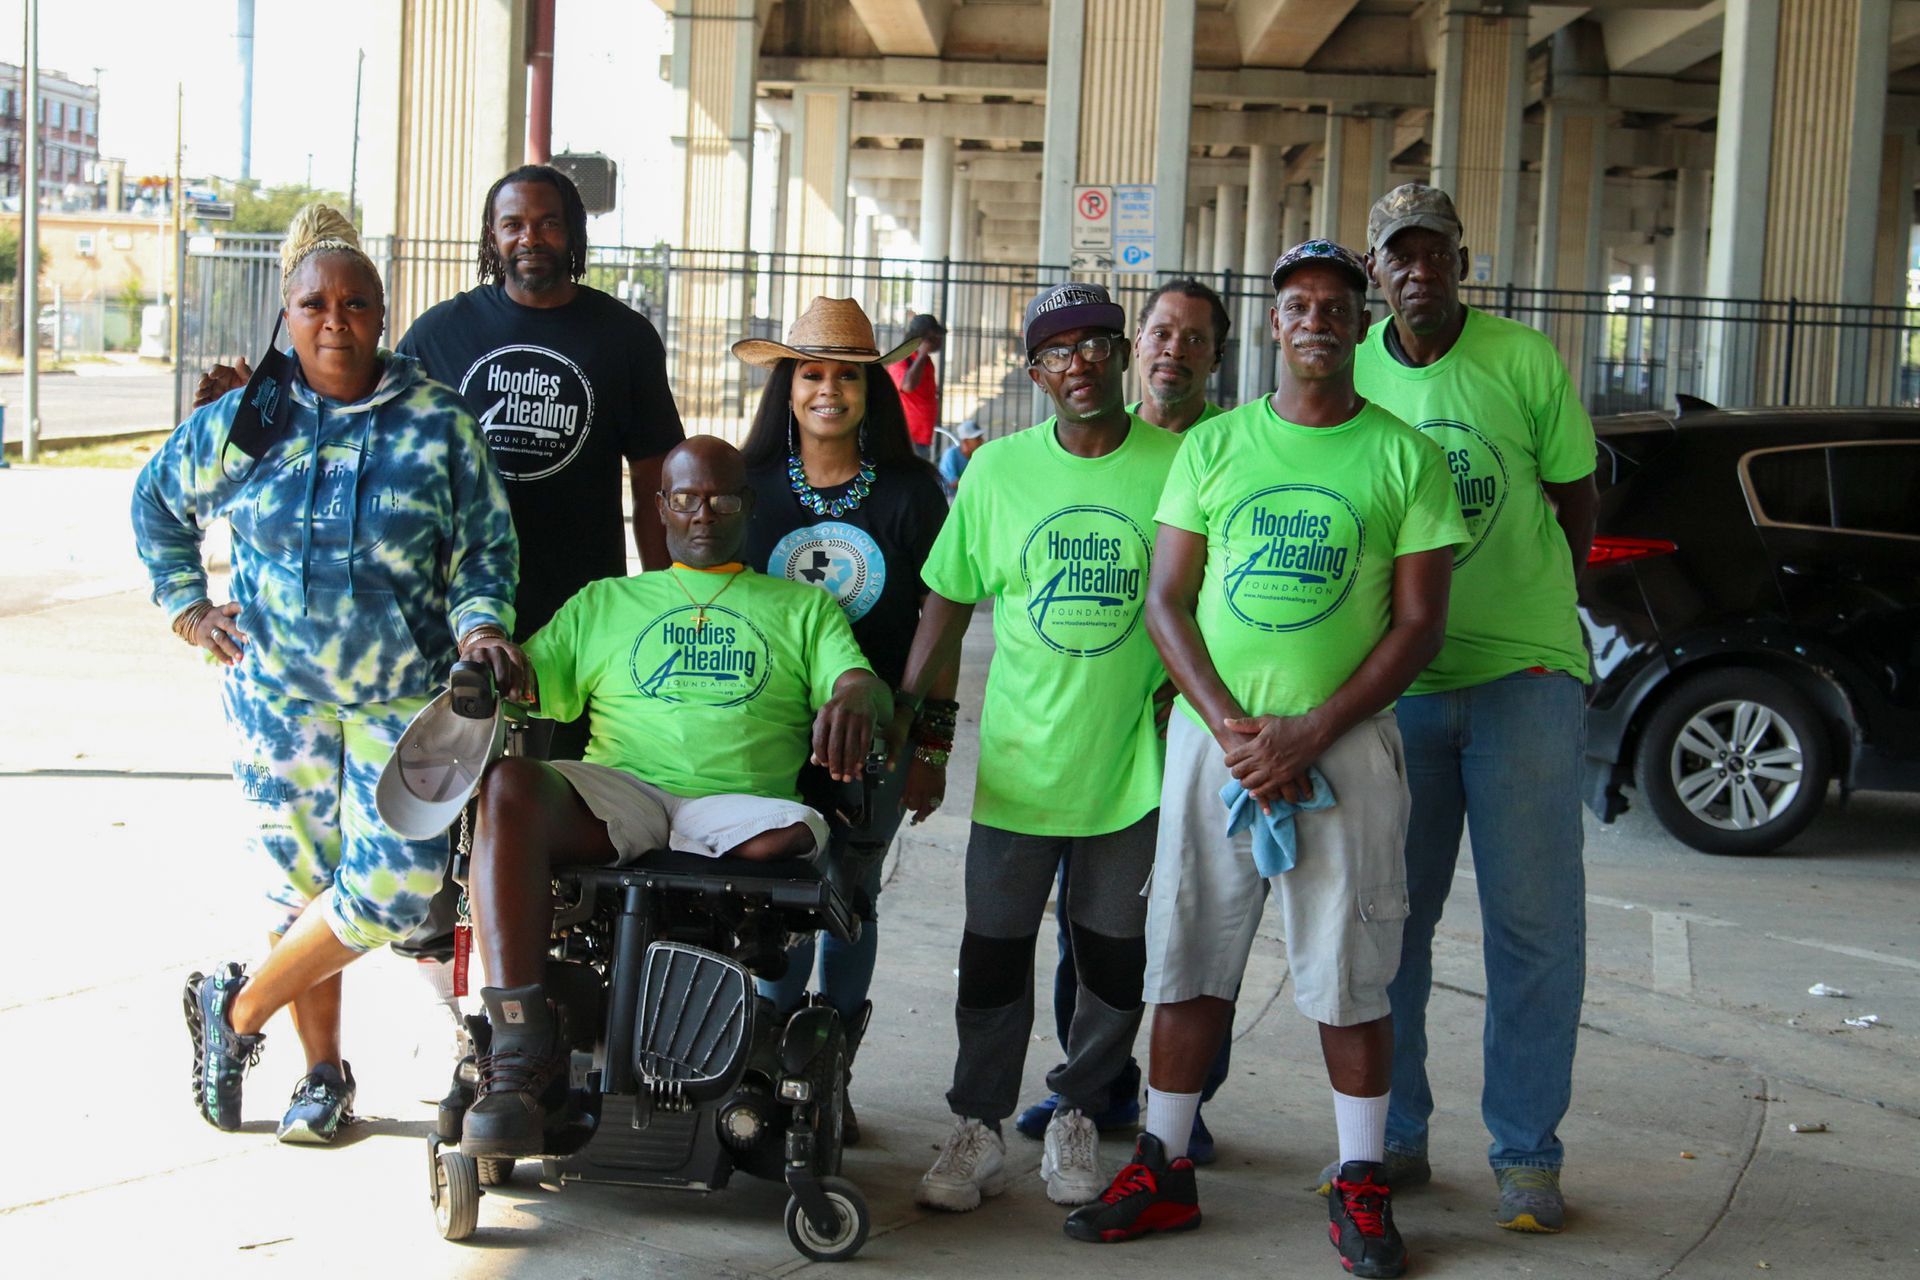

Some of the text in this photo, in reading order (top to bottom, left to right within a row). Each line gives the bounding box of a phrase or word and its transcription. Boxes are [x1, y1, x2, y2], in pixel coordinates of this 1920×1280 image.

[487, 364, 561, 397] Hoodies
[505, 393, 578, 436] Healing
[488, 435, 566, 449] FOUNDATION
[1251, 506, 1331, 539] Hoodies
[776, 526, 876, 557] TEXAS COALITION
[1048, 530, 1121, 561] Hoodies
[1267, 537, 1348, 580] Healing
[1068, 561, 1140, 601] Healing
[1245, 581, 1333, 594] FOUNDATION
[1051, 608, 1130, 617] FOUNDATION
[1243, 593, 1317, 604] www.Hoodies4Healing.org
[663, 622, 736, 645] Hoodies
[1052, 620, 1117, 628] www.Hoodies4Healing.org
[683, 644, 756, 678] Healing
[666, 680, 746, 689] FOUNDATION
[207, 1052, 218, 1085] JUST
